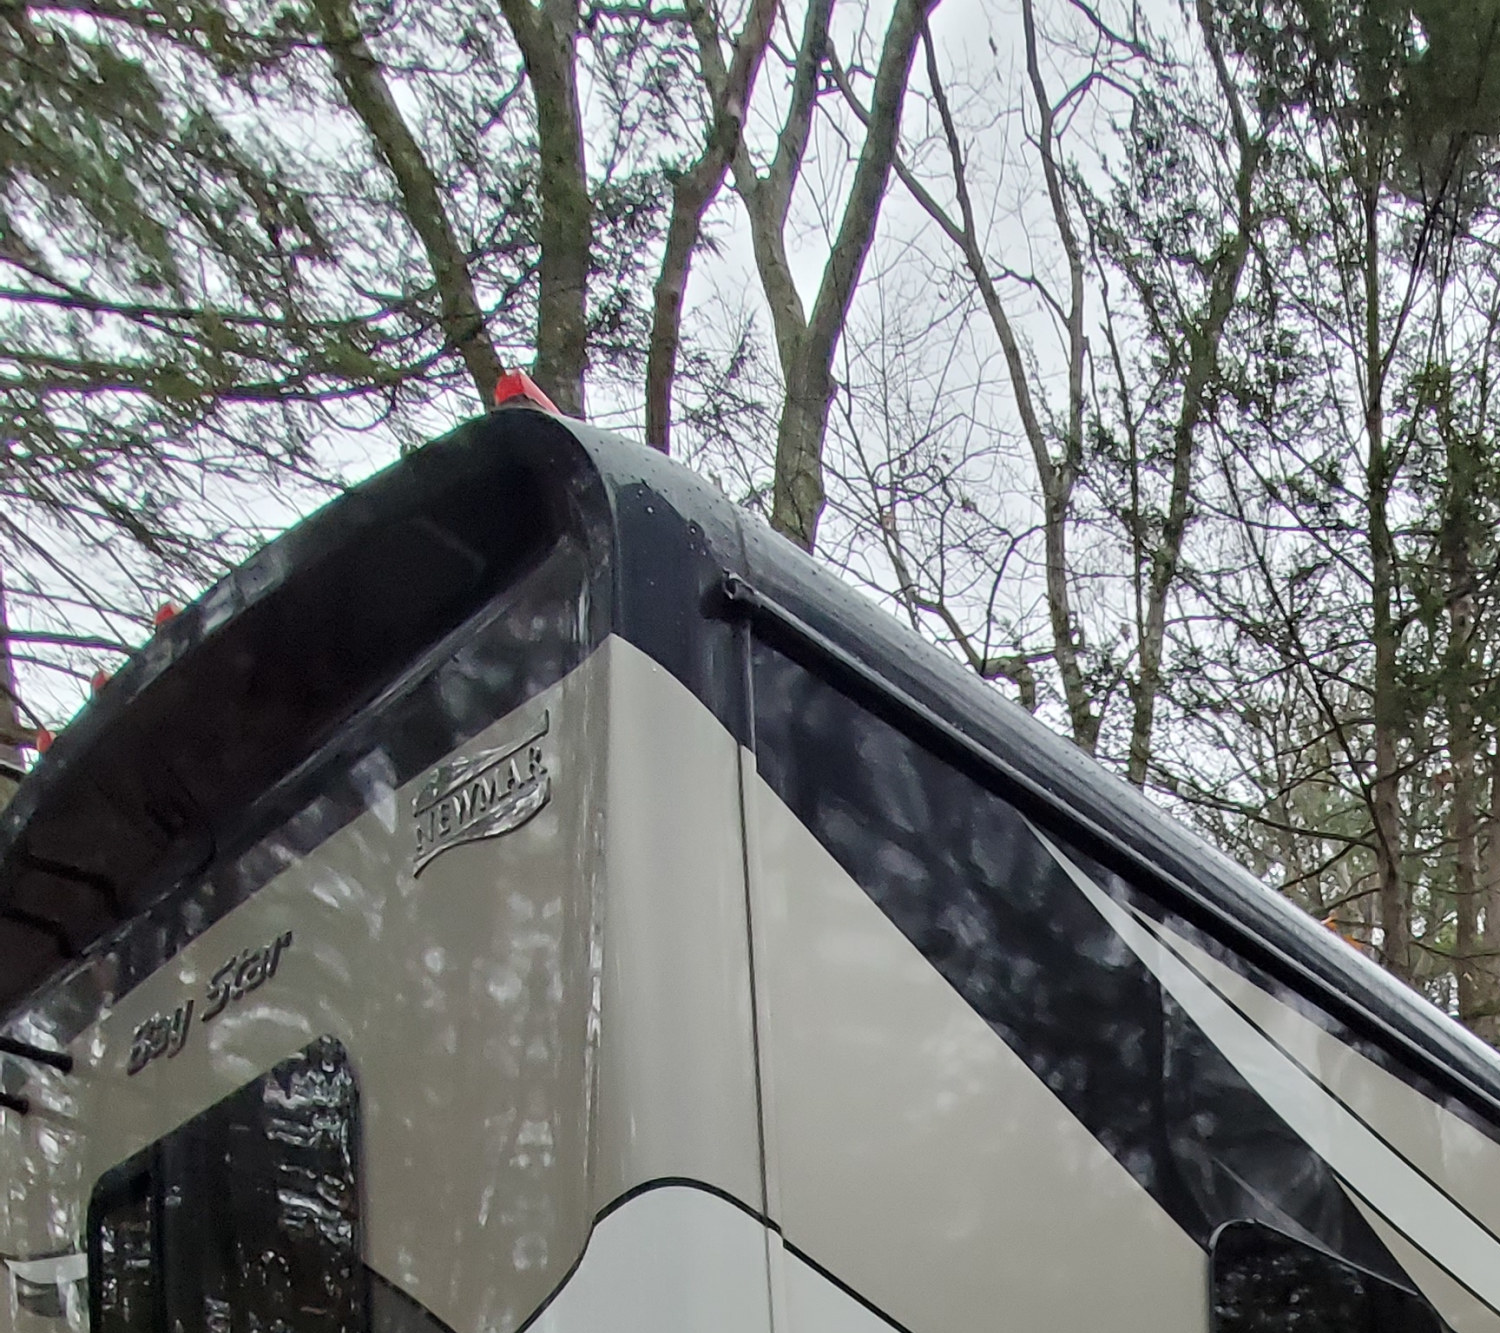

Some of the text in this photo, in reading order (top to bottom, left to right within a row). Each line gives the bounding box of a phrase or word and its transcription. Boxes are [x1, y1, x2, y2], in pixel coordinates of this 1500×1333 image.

[415, 746, 548, 853] NEWMAR
[127, 930, 293, 1076] Bay Star
